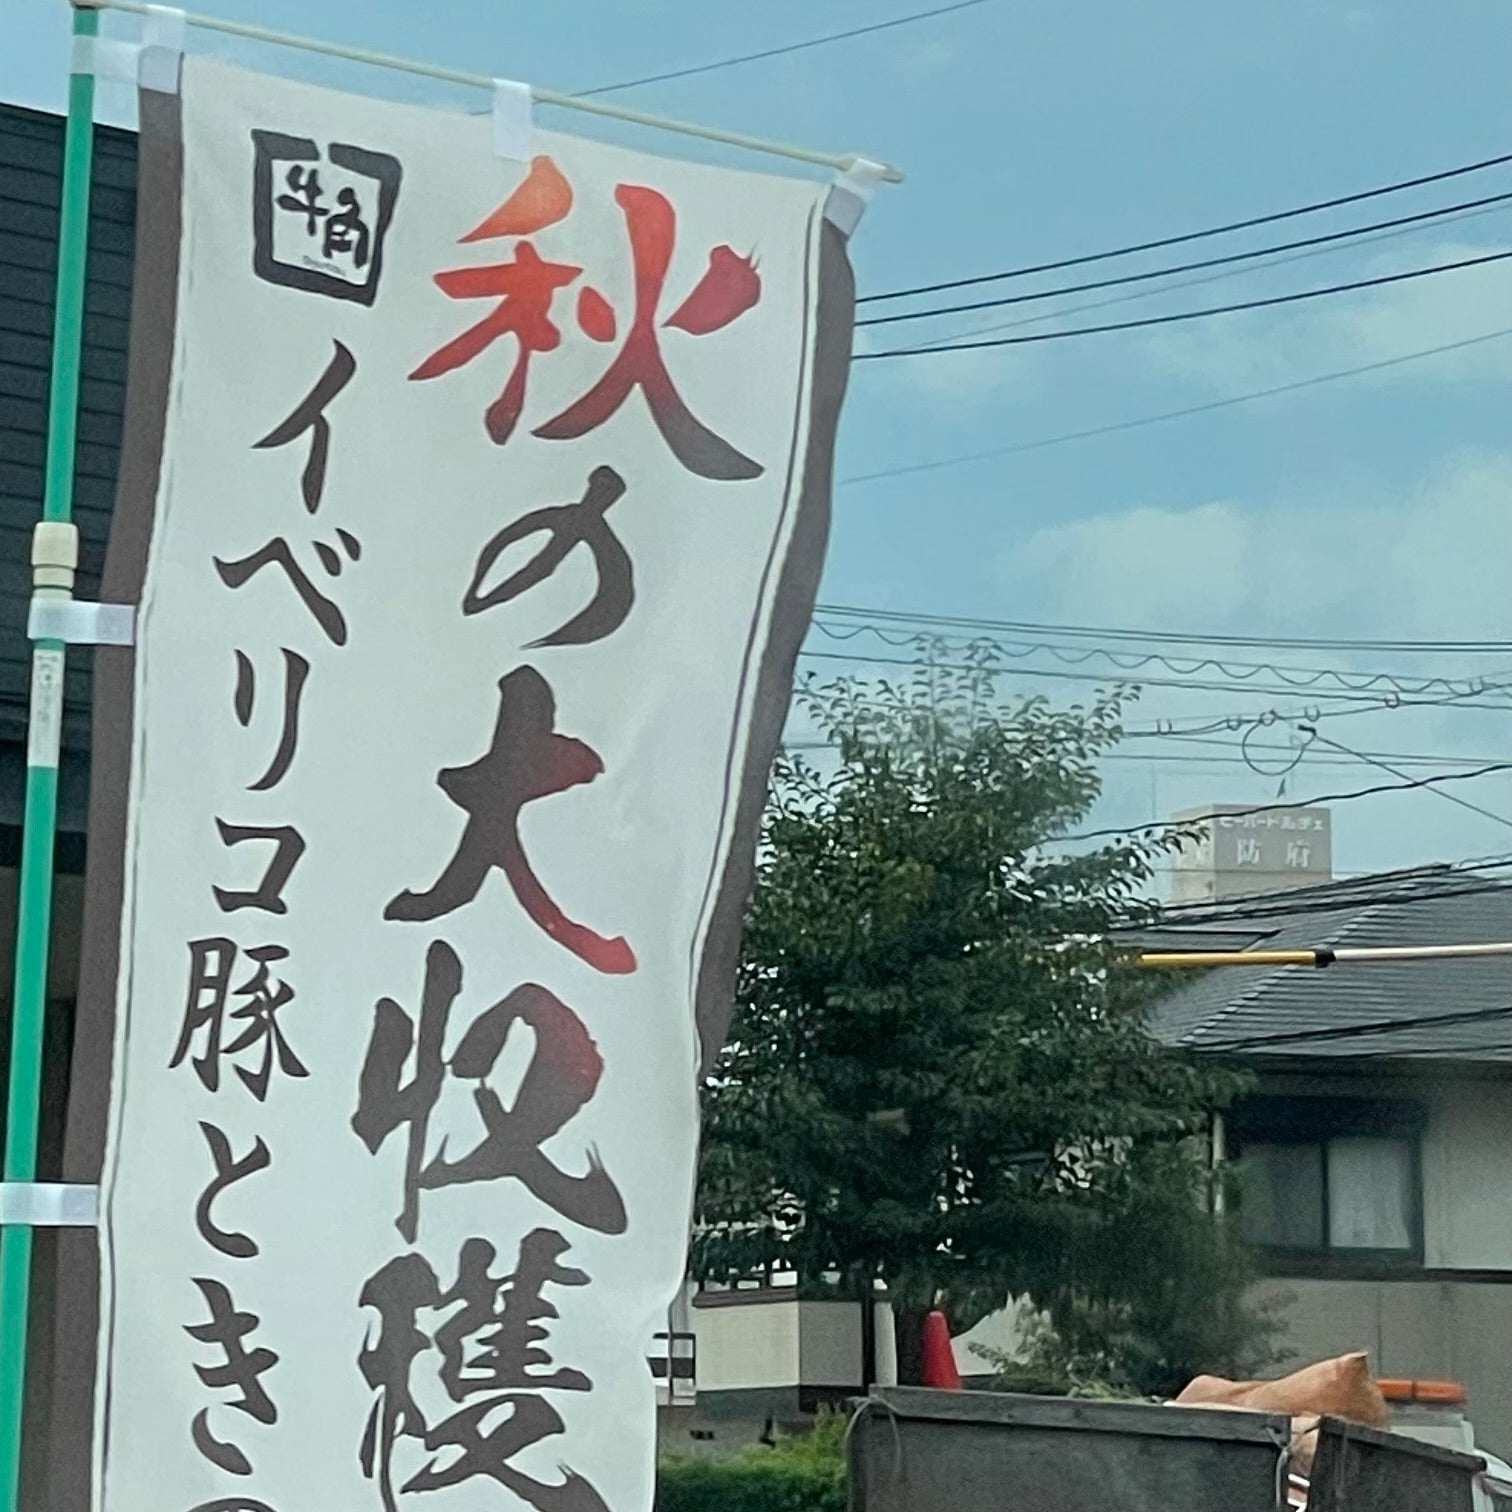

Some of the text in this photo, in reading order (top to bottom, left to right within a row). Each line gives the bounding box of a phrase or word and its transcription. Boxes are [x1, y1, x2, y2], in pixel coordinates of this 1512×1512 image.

[275, 164, 369, 269] 牛角
[168, 339, 361, 1512] イベリコ豚とき
[351, 155, 763, 1512] 秋の大収穫
